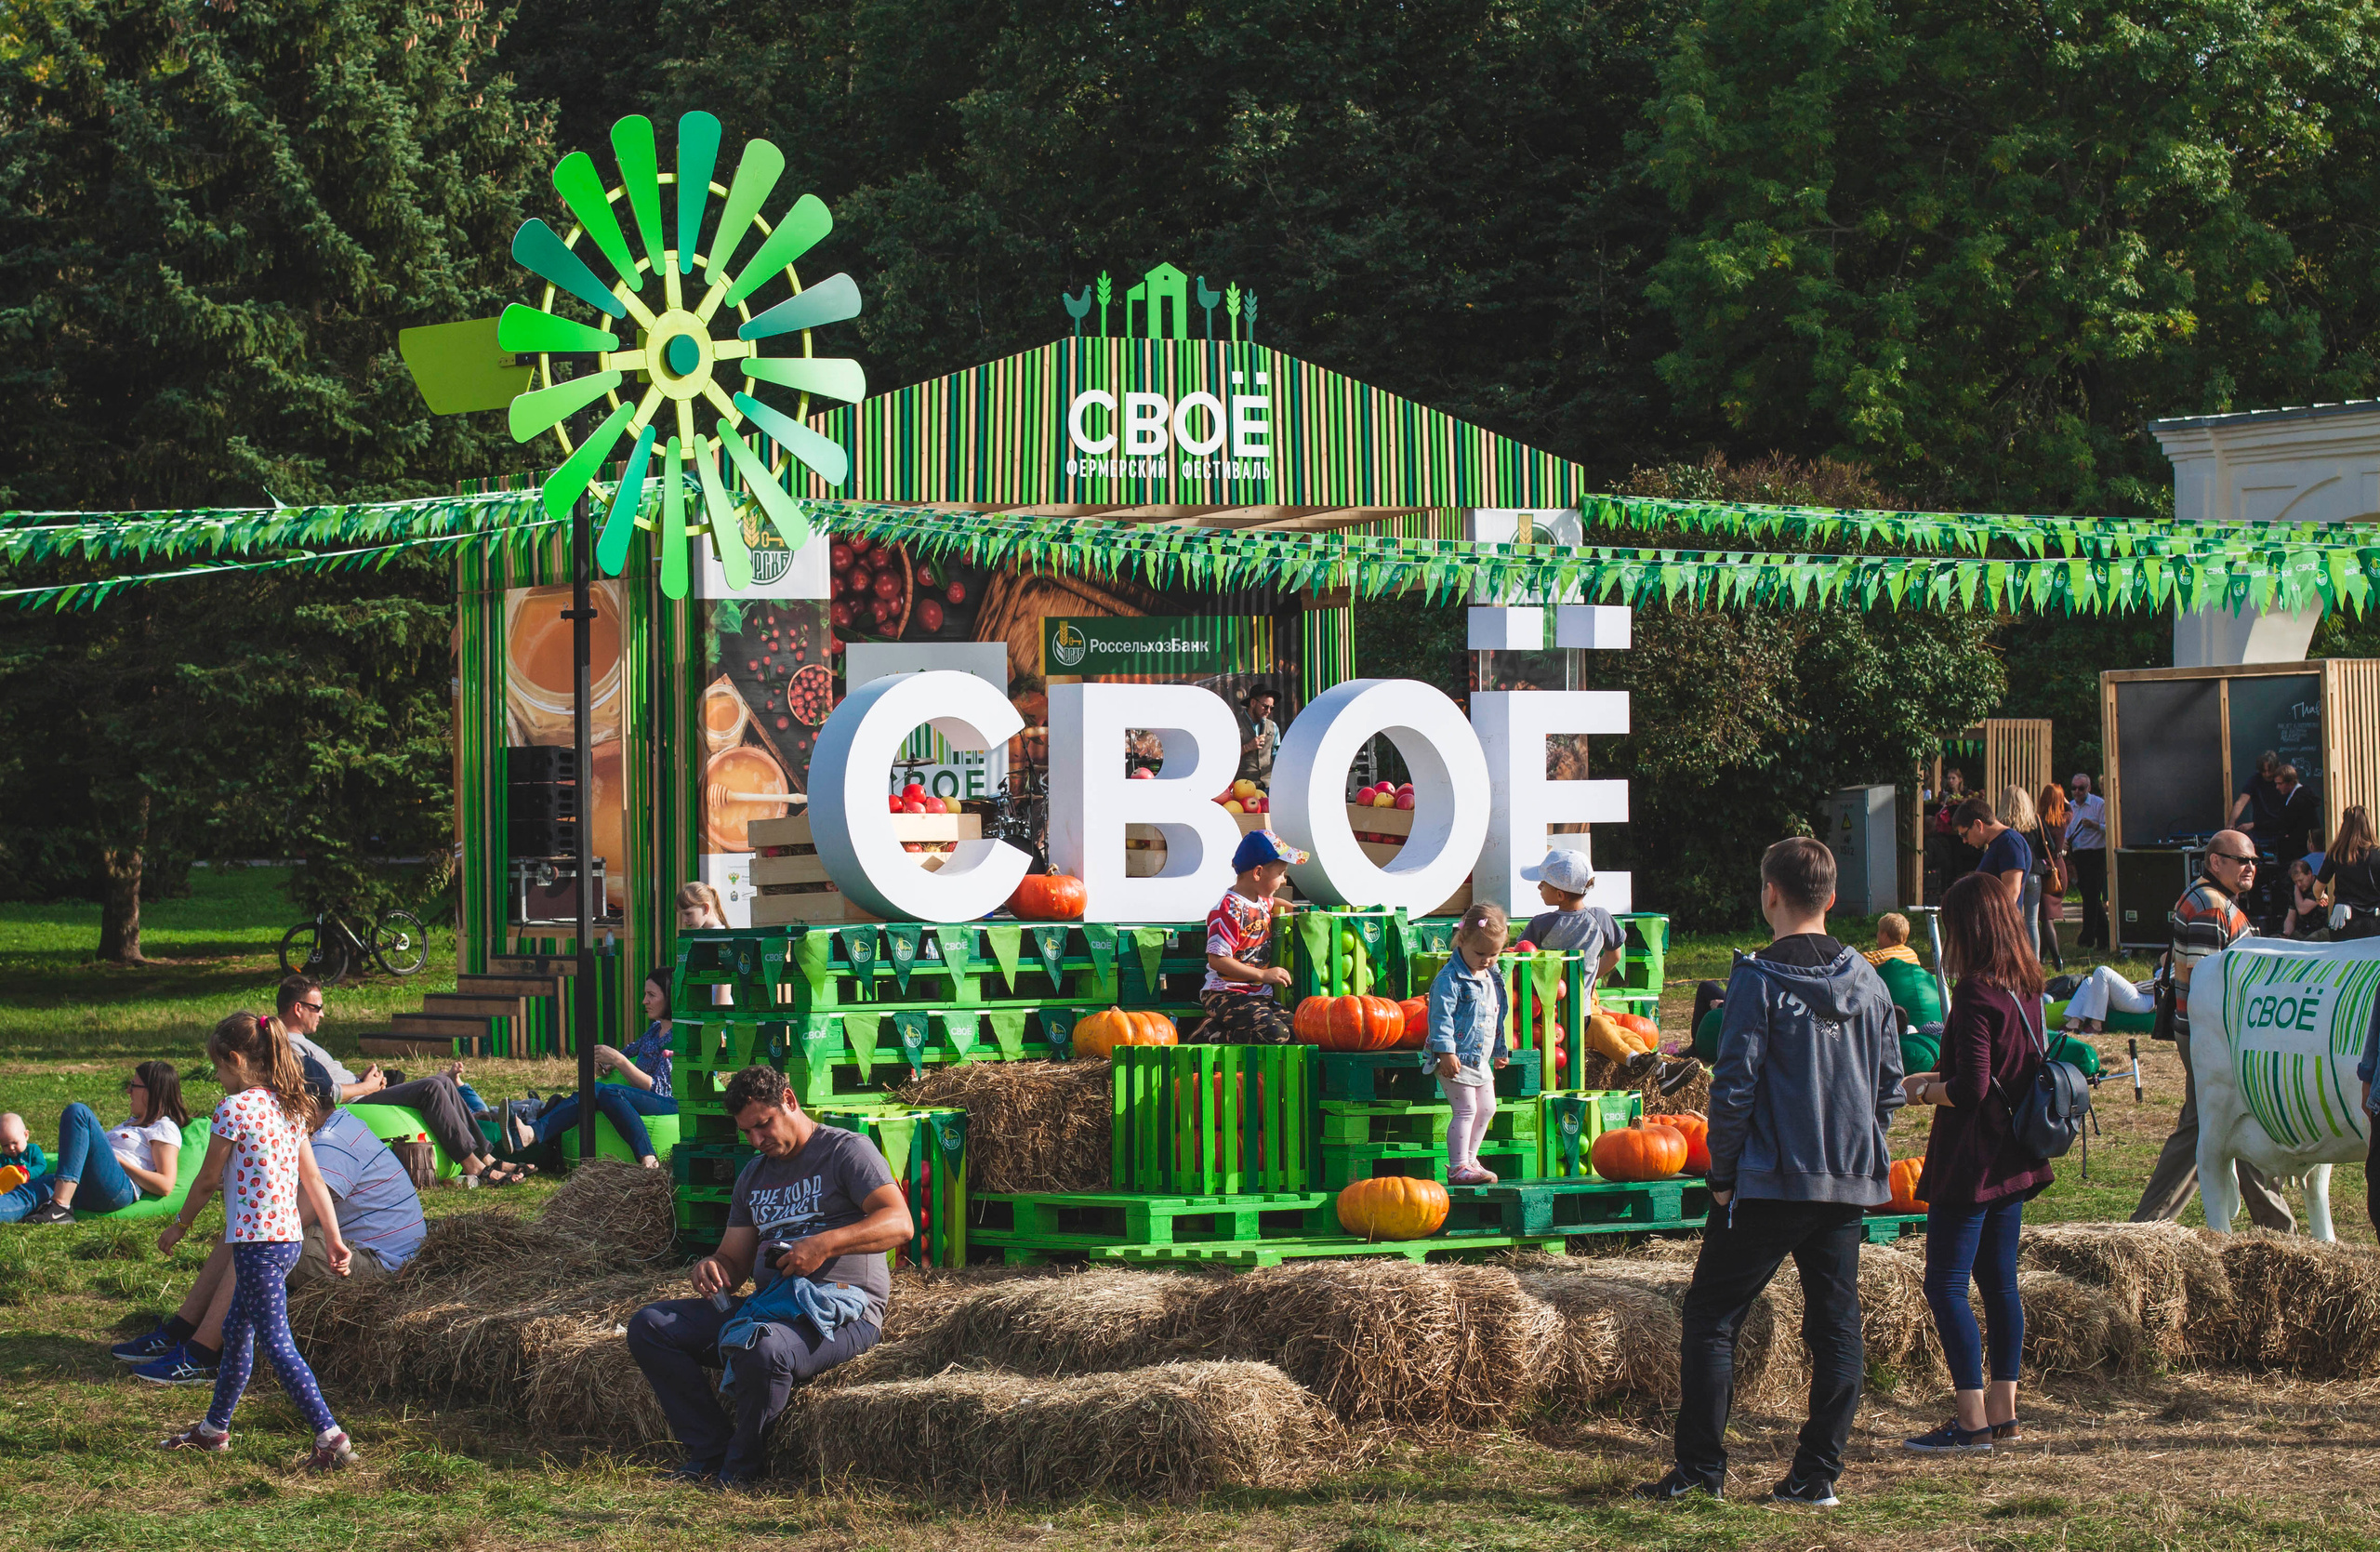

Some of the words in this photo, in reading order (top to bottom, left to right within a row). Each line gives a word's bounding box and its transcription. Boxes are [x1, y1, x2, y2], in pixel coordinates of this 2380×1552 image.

[1068, 371, 1270, 458] СВОЁ
[1066, 457, 1168, 479] ФЕРМЕРСКИЙ
[1182, 460, 1270, 480] ФЕСТИВАЛЬ
[1090, 638, 1209, 654] РоссельхозБанк
[810, 604, 1633, 925] СВОЁ
[944, 938, 969, 951] СВОЁ
[1091, 938, 1113, 950] СВОЁ
[764, 950, 784, 962] СВОЁ
[2247, 987, 2324, 1032] СВОЁ
[801, 1028, 826, 1041] СВОЁ
[950, 1024, 972, 1036] СВОЁ
[1604, 1109, 1626, 1121] СВОЁ
[748, 1188, 781, 1206] THE
[783, 1174, 822, 1205] ROAD
